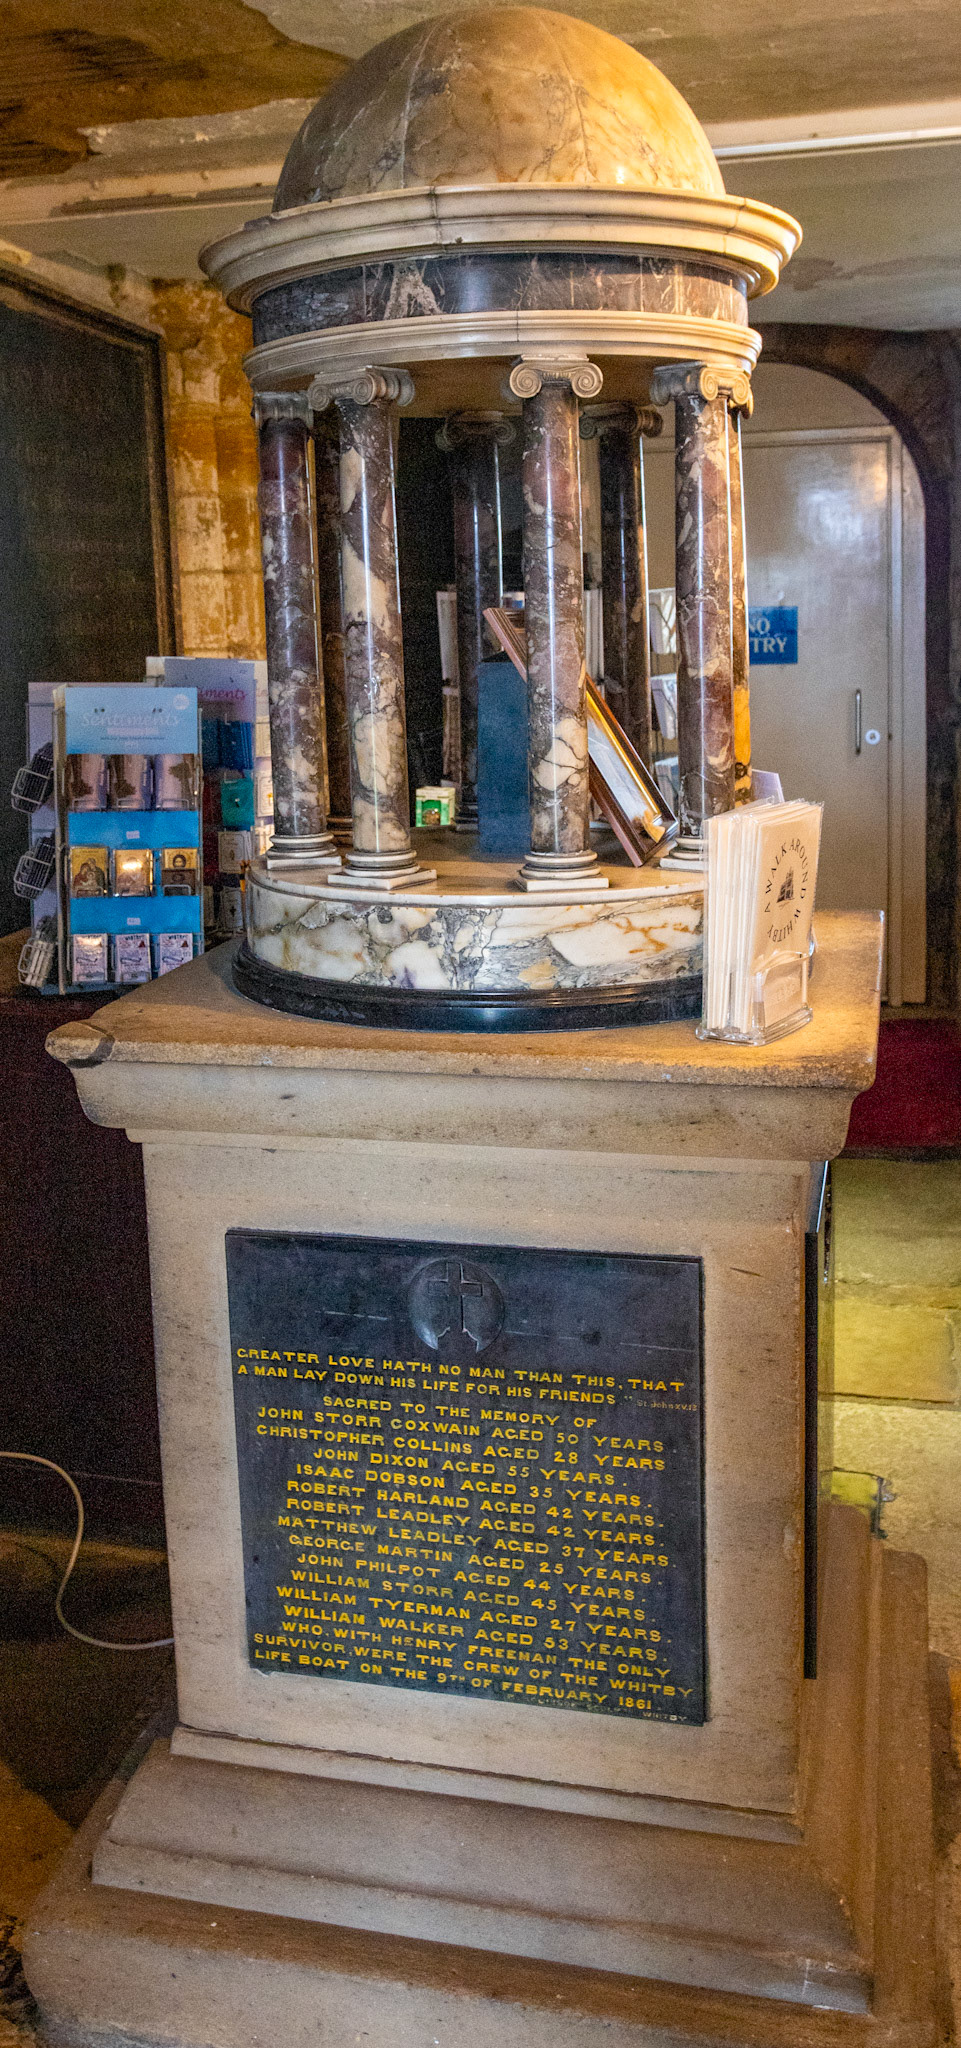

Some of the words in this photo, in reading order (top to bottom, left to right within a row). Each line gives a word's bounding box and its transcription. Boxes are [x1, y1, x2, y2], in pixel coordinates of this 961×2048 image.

[749, 636, 788, 653] TRY
[765, 842, 787, 894] WALK
[788, 838, 809, 899] AROUND
[766, 909, 801, 943] WHITBY
[237, 1348, 319, 1363] GREATER
[329, 1355, 374, 1368] LOVE
[383, 1360, 431, 1372] HATH
[439, 1365, 461, 1375] NO
[470, 1368, 504, 1378] MAN
[514, 1371, 562, 1383] THAN
[572, 1375, 622, 1389] THIS,
[628, 1379, 684, 1391] THAT
[238, 1365, 247, 1374] A
[254, 1366, 287, 1377] MAN
[294, 1369, 327, 1380] LAY
[335, 1372, 384, 1385] DOWN
[391, 1377, 416, 1388] HIS
[423, 1380, 459, 1392] LIFE
[466, 1383, 500, 1395] FOR
[507, 1387, 532, 1397] HIS
[258, 1407, 303, 1420] JOHN
[314, 1412, 381, 1427] STORR
[391, 1419, 480, 1436] COXWAIN
[492, 1428, 543, 1441] AGED
[557, 1433, 578, 1444] 50
[594, 1436, 663, 1452] YEARS
[323, 1396, 391, 1411] SACRED
[400, 1403, 425, 1413] TO
[435, 1406, 470, 1417] THE
[481, 1409, 560, 1425] MEMORY
[574, 1417, 596, 1428] OF
[257, 1425, 384, 1446] CHRISTOPHER
[394, 1437, 472, 1454] COLLINS
[484, 1446, 539, 1459] AGED
[554, 1451, 578, 1464] 28
[594, 1455, 664, 1470] YEARS
[314, 1448, 358, 1461] JOHN
[370, 1453, 428, 1468] DIXON
[442, 1460, 495, 1474] AGED
[507, 1466, 528, 1477] 55
[287, 1481, 365, 1497] ROBERT
[377, 1490, 469, 1508] HARLAND
[480, 1500, 536, 1514] AGED
[546, 1506, 573, 1518] 42
[297, 1464, 354, 1479] ISAAC
[365, 1470, 445, 1488] DOBSON
[460, 1480, 516, 1494] AGED
[530, 1486, 552, 1498] 35
[278, 1516, 376, 1535] MATTHEW
[389, 1528, 481, 1546] LEADLEY
[494, 1539, 549, 1554] AGED
[562, 1546, 584, 1558] 37
[287, 1498, 364, 1515] ROBERT
[377, 1507, 470, 1526] LEADLEY
[479, 1519, 535, 1533] AGED
[547, 1526, 575, 1537] 42
[289, 1535, 364, 1551] GEORGE
[377, 1544, 452, 1561] MARTIN
[469, 1555, 524, 1569] AGED
[539, 1562, 563, 1574] 25
[297, 1553, 343, 1567] JOHN
[356, 1560, 440, 1577] PHILPOT
[454, 1571, 510, 1586] AGED
[524, 1579, 551, 1591] 44
[277, 1586, 356, 1605] WILLIAM
[368, 1598, 470, 1619] TYERMAN
[480, 1611, 537, 1627] AGED
[550, 1619, 576, 1631] 27
[291, 1570, 369, 1588] WILLIAM
[382, 1581, 452, 1597] STORR
[464, 1591, 519, 1606] AGED
[531, 1599, 556, 1610] 45
[284, 1605, 365, 1624] WILLIAM
[379, 1617, 464, 1636] WALKER
[475, 1629, 533, 1645] AGED
[544, 1637, 568, 1650] 53
[334, 1628, 381, 1642] WITH
[392, 1636, 456, 1651] HENRY
[468, 1645, 556, 1664] FREEMAN
[568, 1658, 607, 1671] THE
[618, 1664, 670, 1678] ONLY
[354, 1647, 406, 1661] WERE
[416, 1655, 452, 1667] THE
[464, 1661, 519, 1676] CREW
[529, 1669, 551, 1679] OF
[560, 1673, 597, 1685] THE
[610, 1679, 692, 1696] WHITBY
[256, 1650, 291, 1662] LIFE
[299, 1655, 349, 1669] BOAT
[360, 1663, 382, 1674] ON
[390, 1667, 426, 1680] THE
[472, 1678, 492, 1688] OF
[502, 1682, 607, 1703] FEBRUARY
